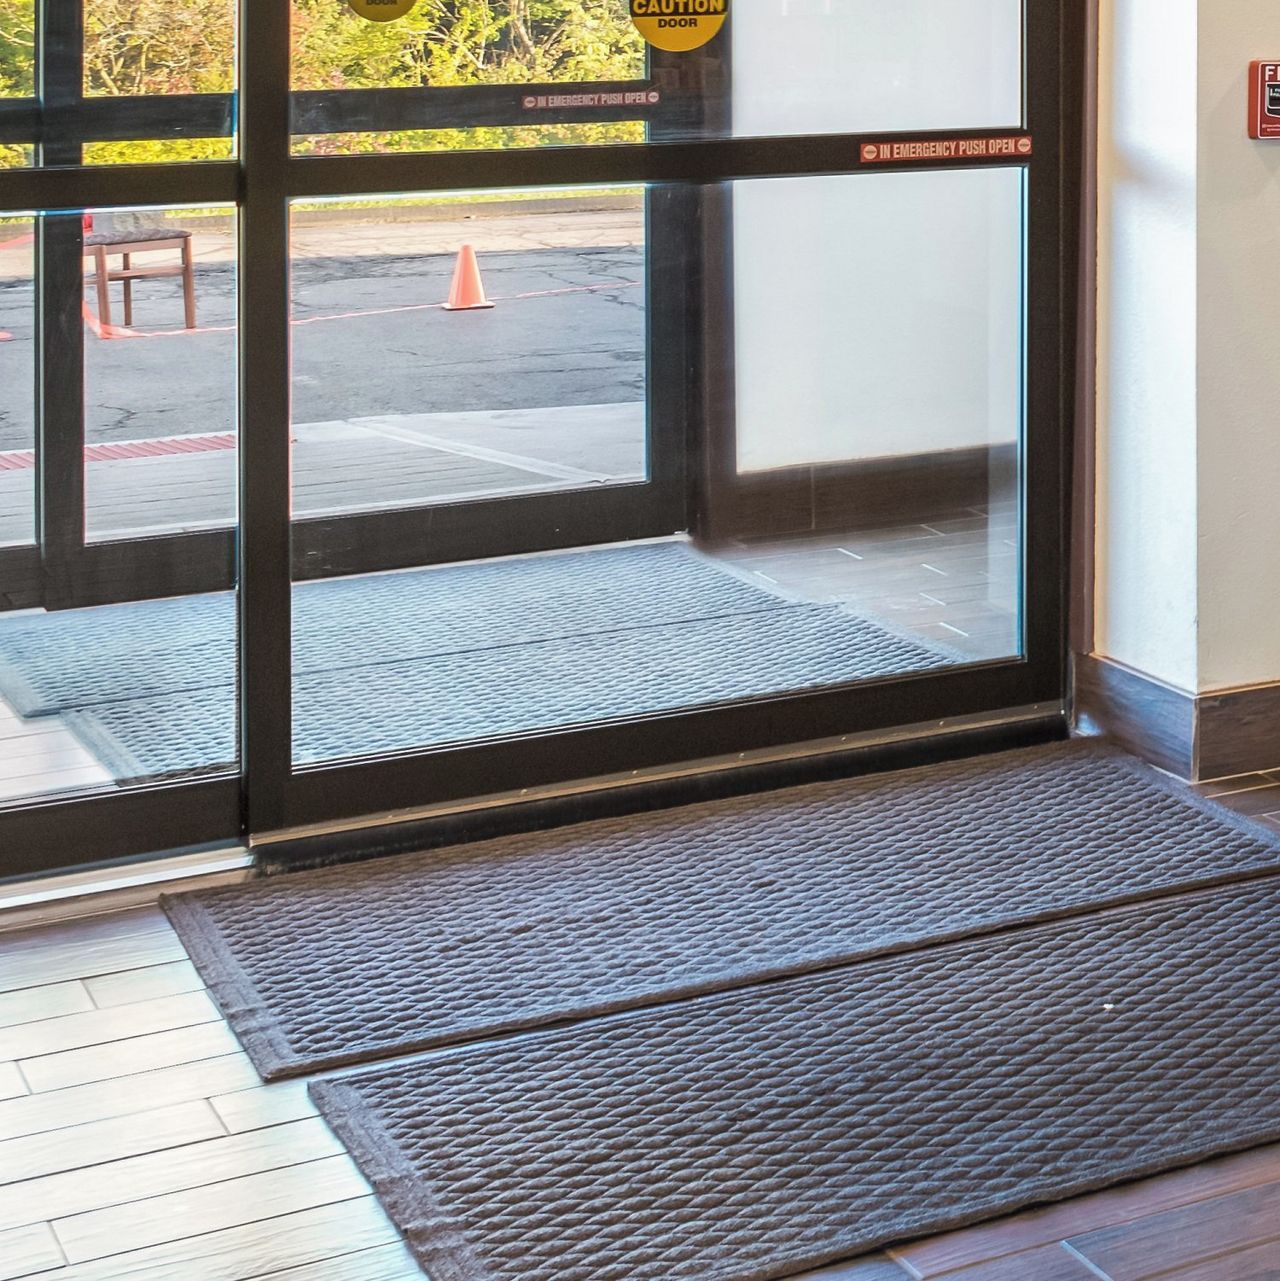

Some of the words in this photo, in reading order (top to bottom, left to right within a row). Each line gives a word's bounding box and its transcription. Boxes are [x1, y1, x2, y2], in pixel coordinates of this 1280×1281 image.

[658, 18, 698, 28] DOOR
[537, 96, 547, 107] IN
[549, 94, 599, 107] EMERGENCY
[601, 93, 623, 105] PUSH
[624, 92, 646, 104] OPEN
[880, 145, 890, 158] IN
[894, 142, 956, 157] EMERGENCY
[959, 140, 986, 155] PUSH
[988, 138, 1015, 153] OPEN
